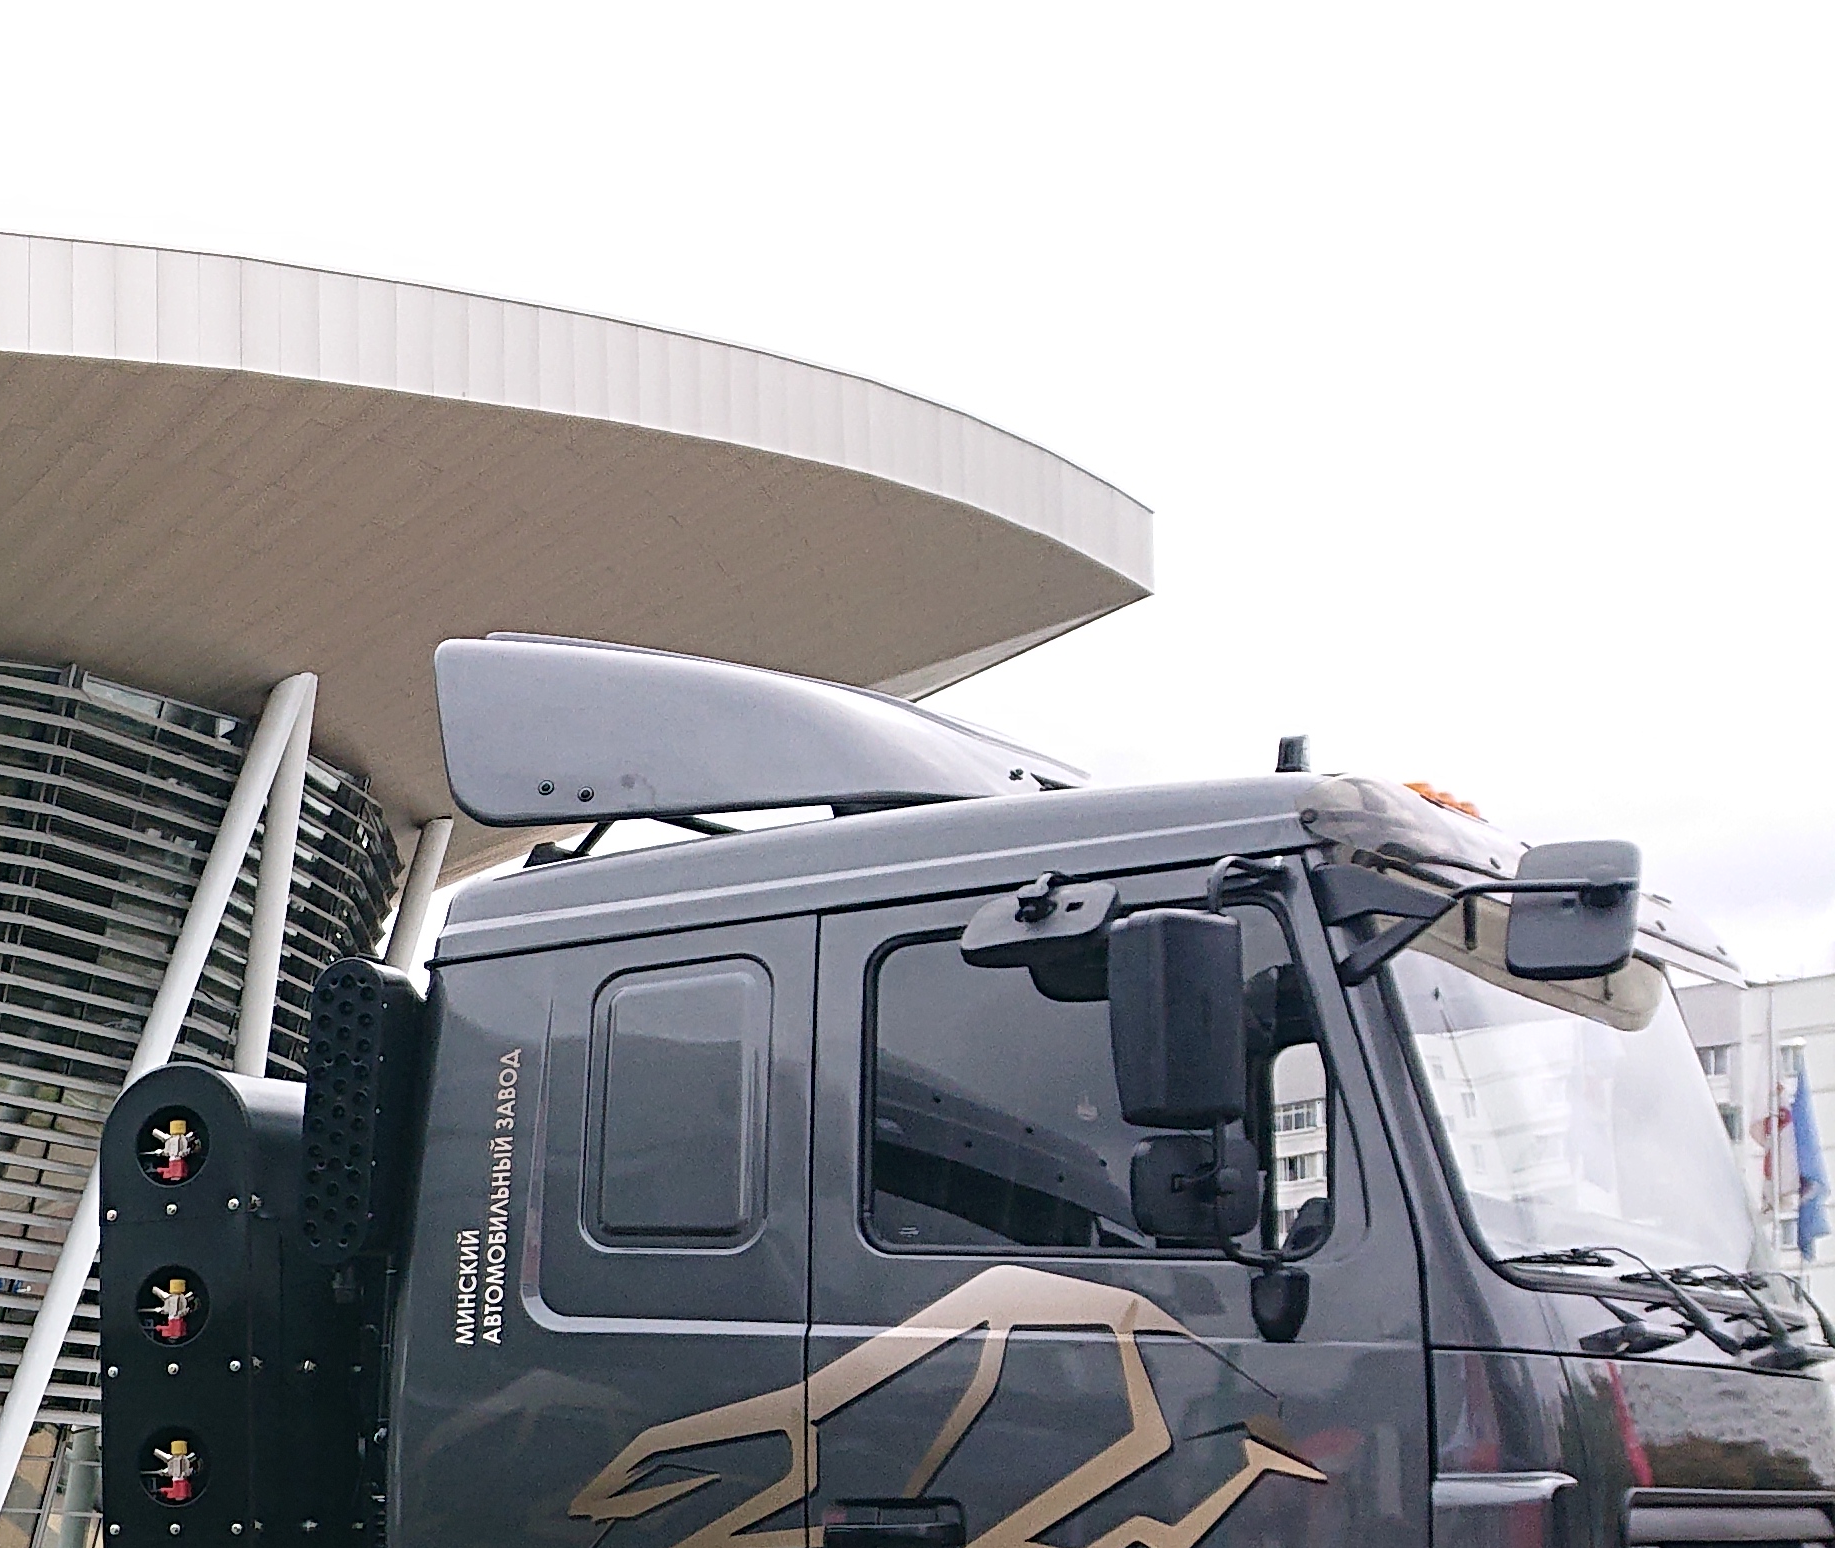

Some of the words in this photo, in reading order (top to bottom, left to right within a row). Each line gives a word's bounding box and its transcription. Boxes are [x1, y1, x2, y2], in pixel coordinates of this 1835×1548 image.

[495, 1048, 522, 1131] ЗАВОД
[455, 1229, 480, 1346] МИНСКИЙ
[483, 1136, 514, 1345] АВТОМОБИЛЬНЫЙ
